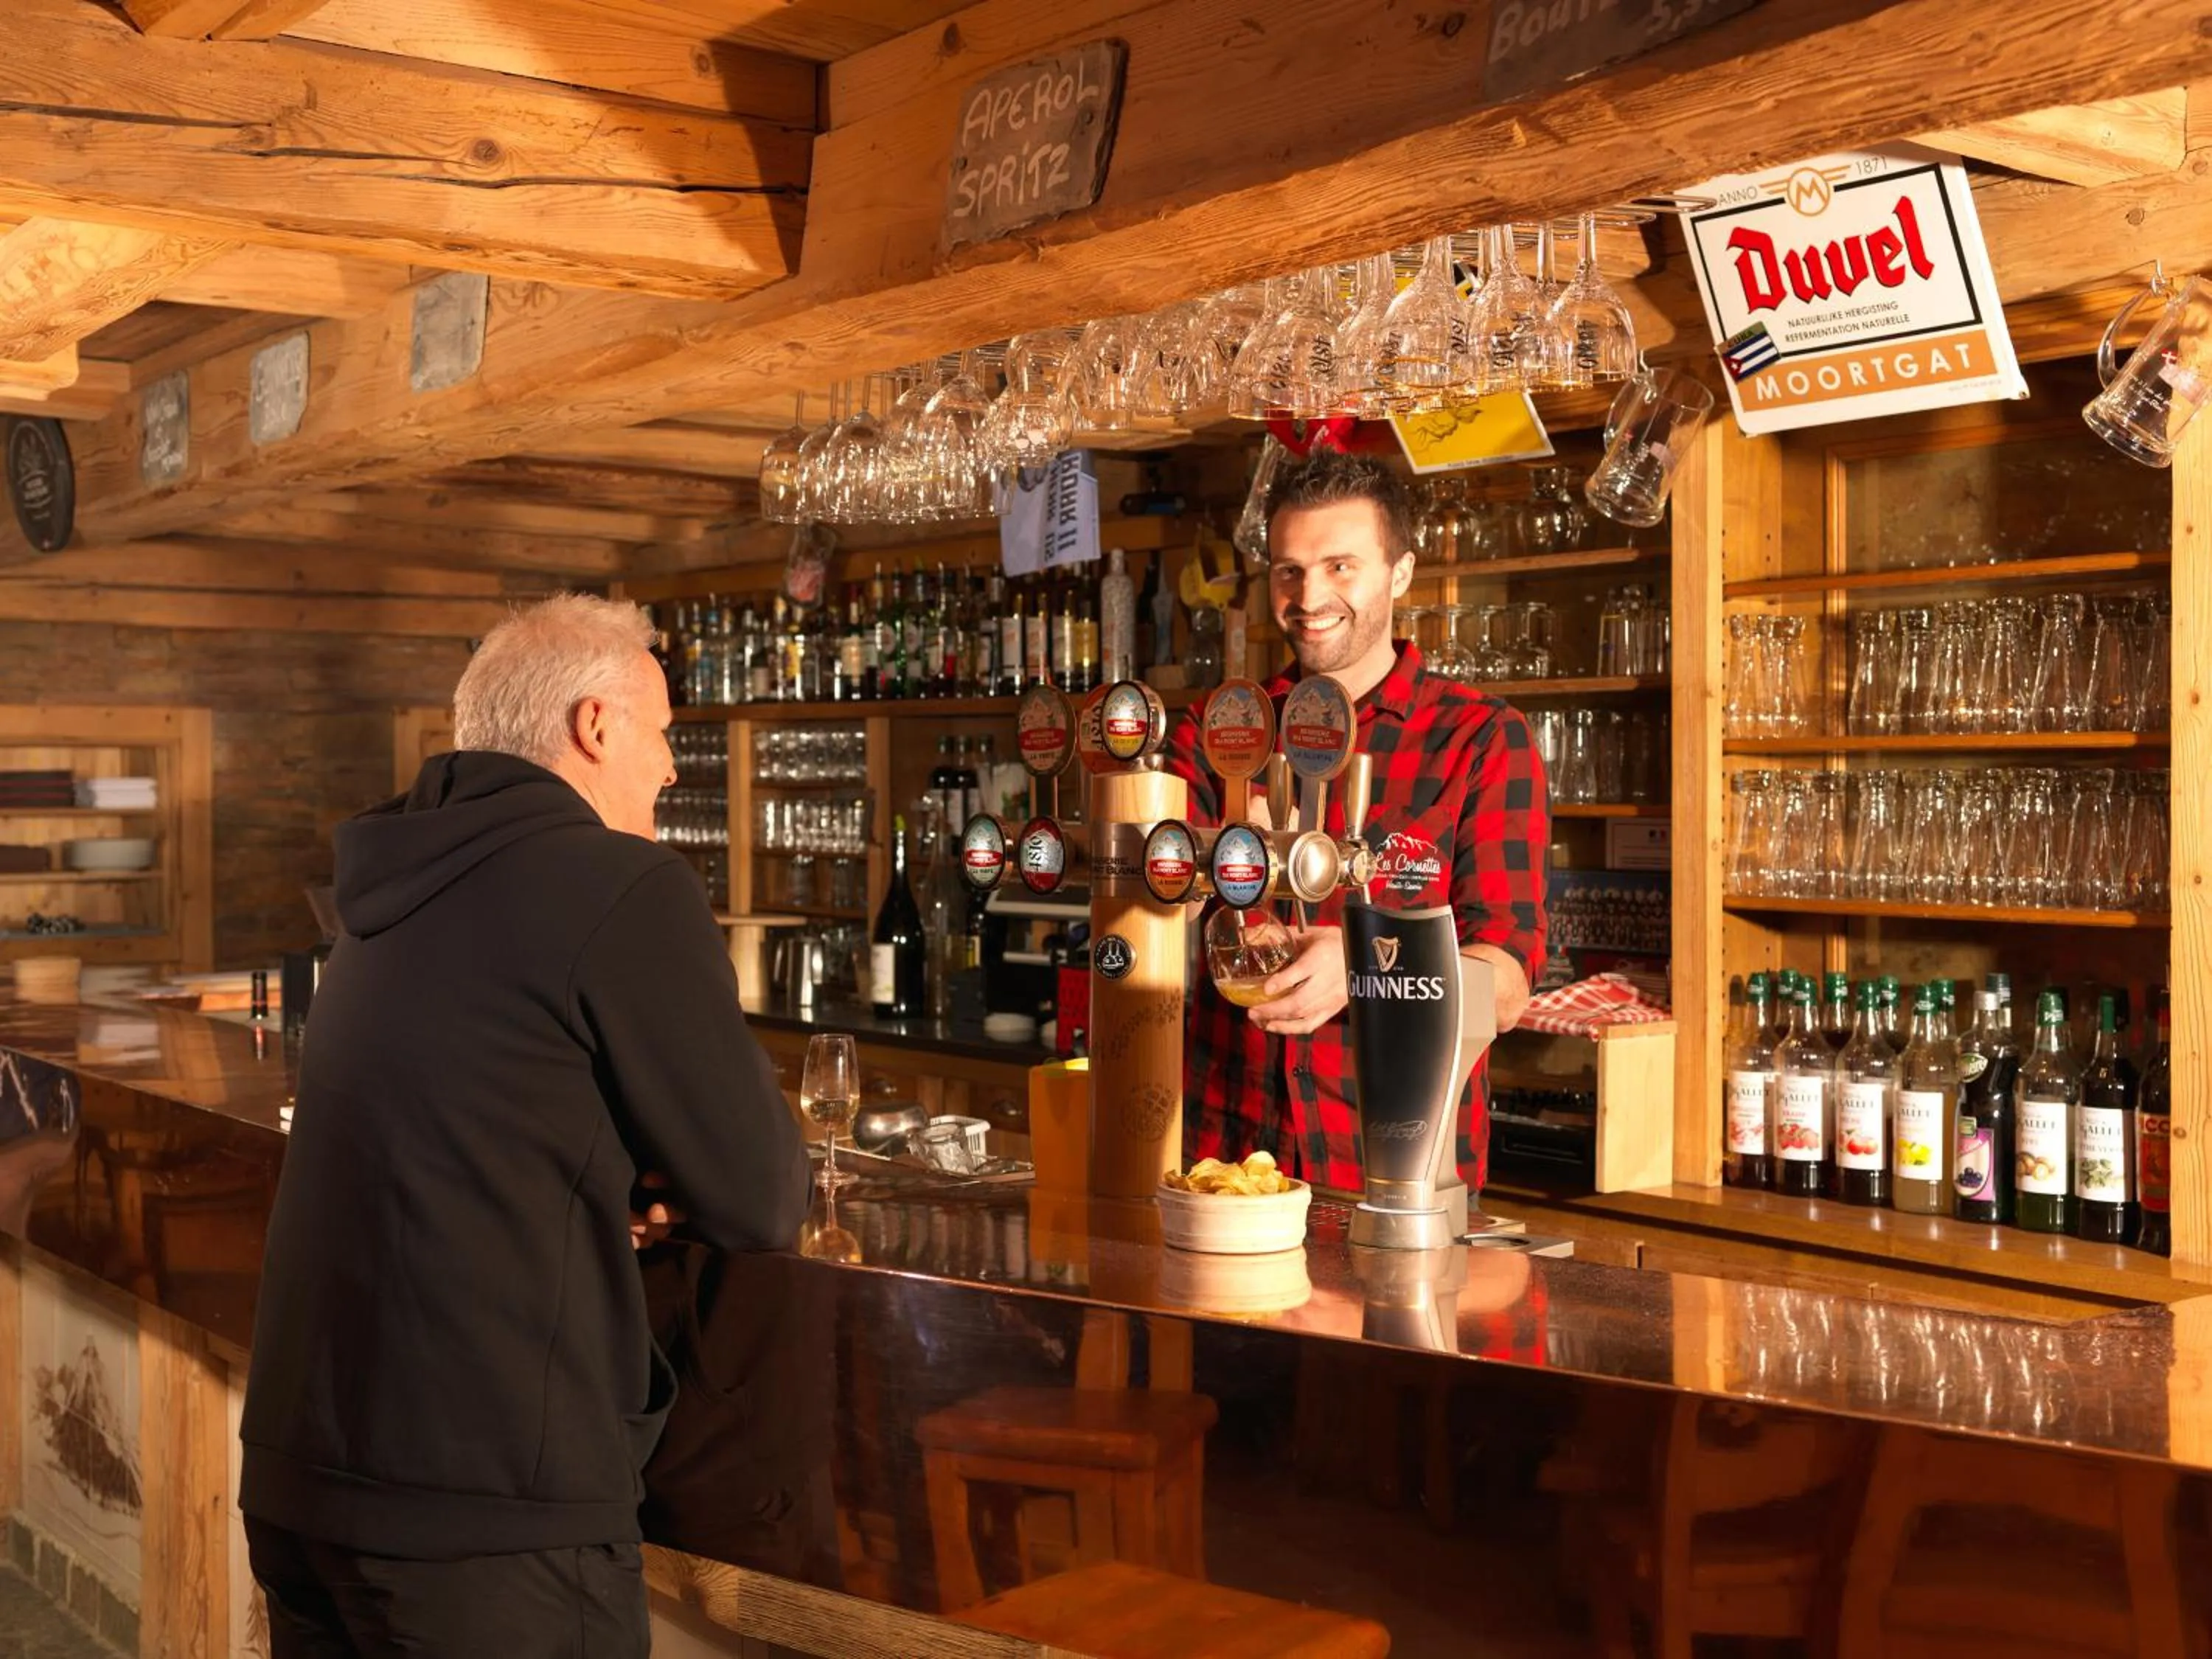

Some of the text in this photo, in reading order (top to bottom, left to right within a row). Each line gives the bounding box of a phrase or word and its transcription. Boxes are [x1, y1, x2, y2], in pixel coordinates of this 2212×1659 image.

[962, 59, 1099, 147] APEROL
[1719, 157, 1888, 206] ANNO 1871
[1725, 195, 1935, 315] Duvel
[1845, 301, 1899, 320] HERGISTING
[1861, 313, 1910, 332] NATURELLE
[1756, 343, 1973, 402] MOORTGAT
[1347, 970, 1445, 1001] GUINNESS
